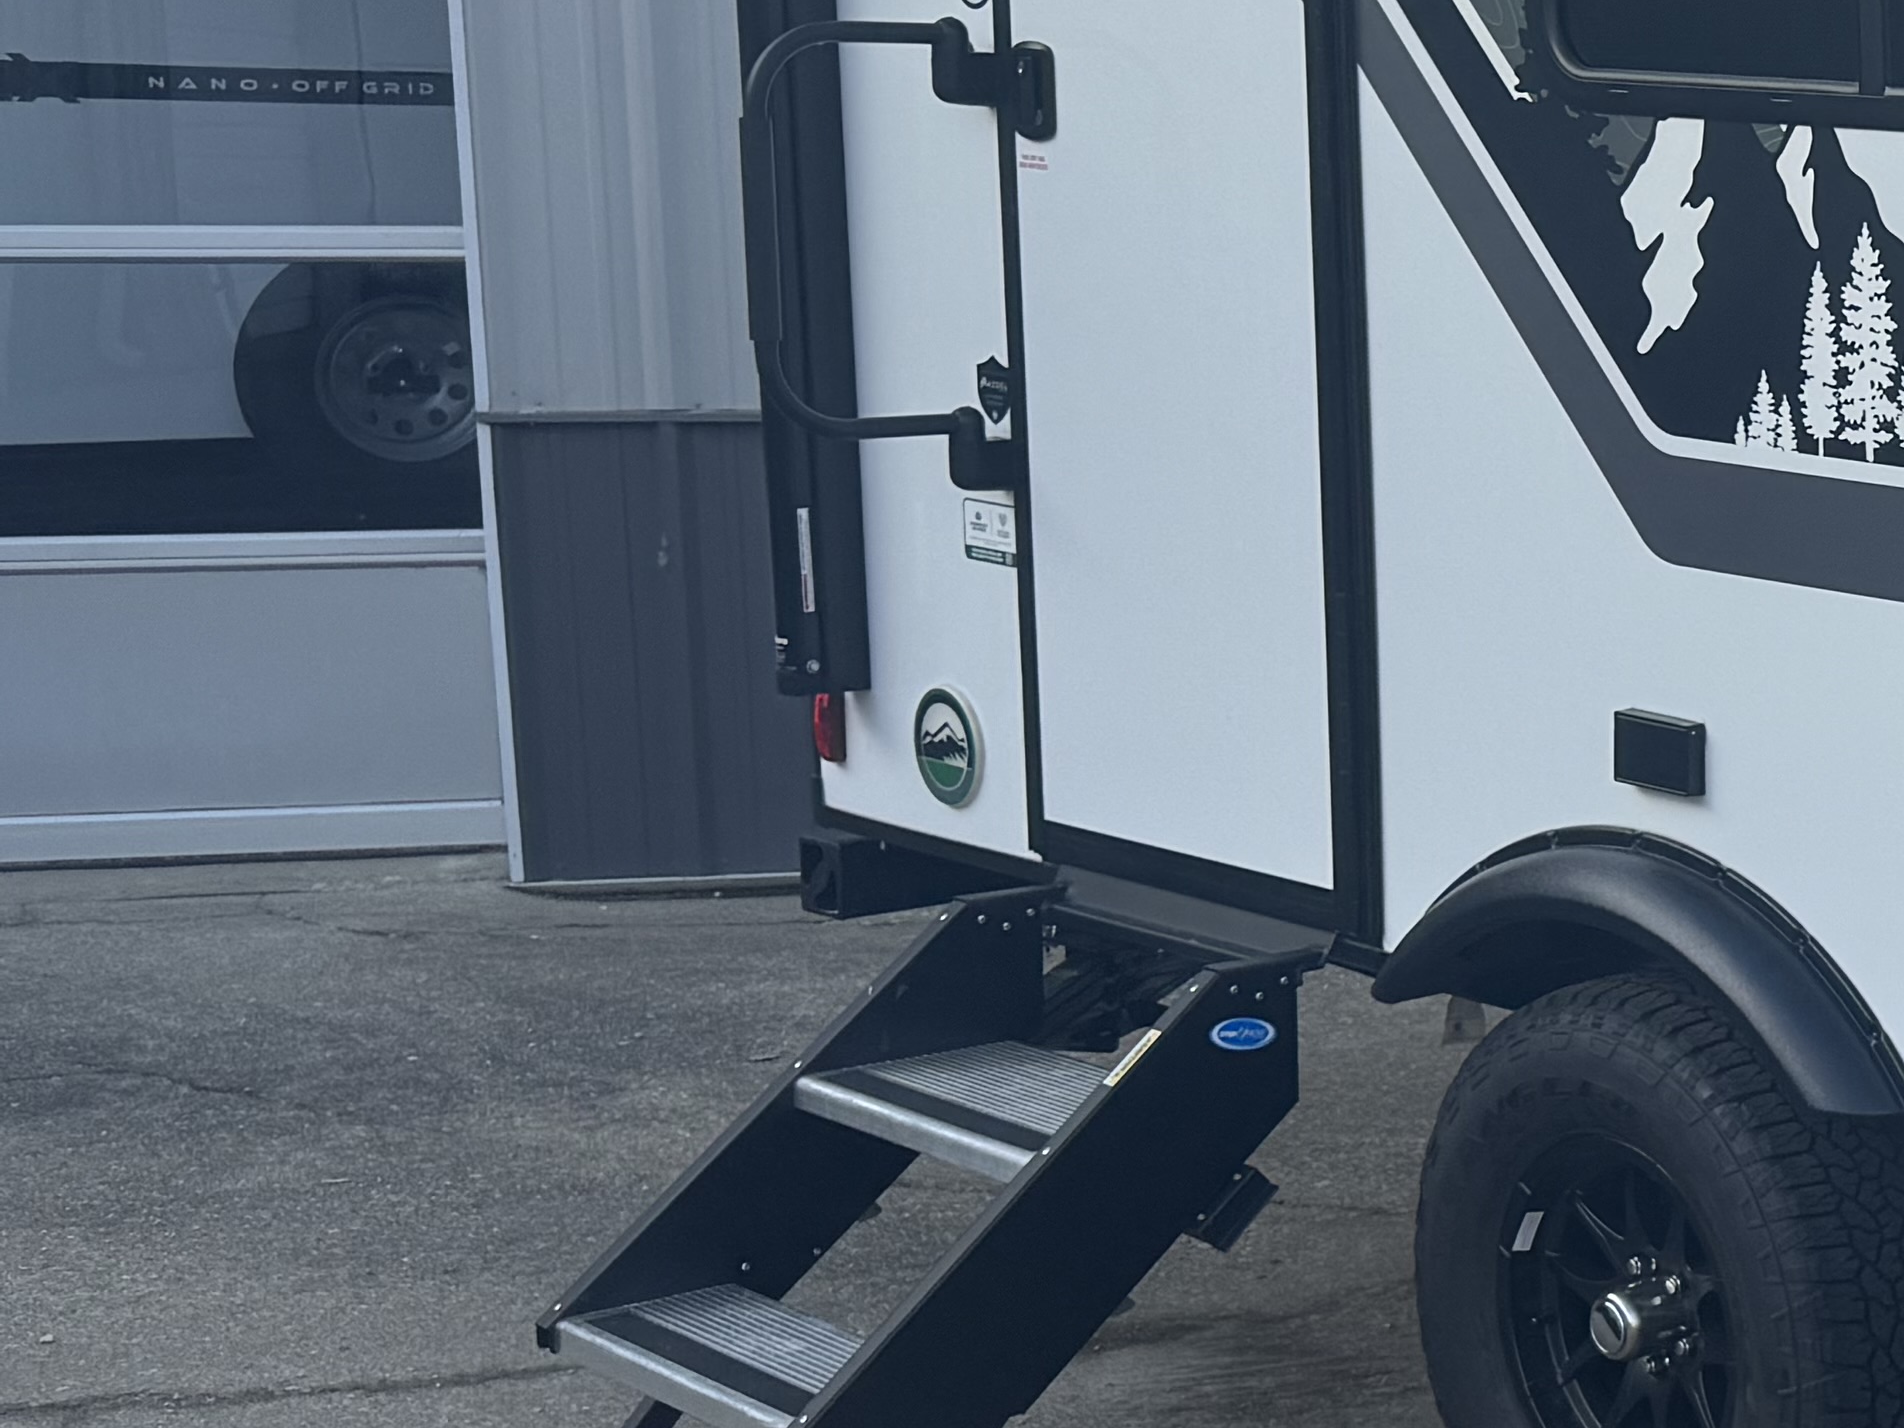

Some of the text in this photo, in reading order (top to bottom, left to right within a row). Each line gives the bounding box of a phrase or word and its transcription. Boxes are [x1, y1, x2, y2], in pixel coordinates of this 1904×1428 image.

[148, 76, 434, 95] NANO OFF GRID
